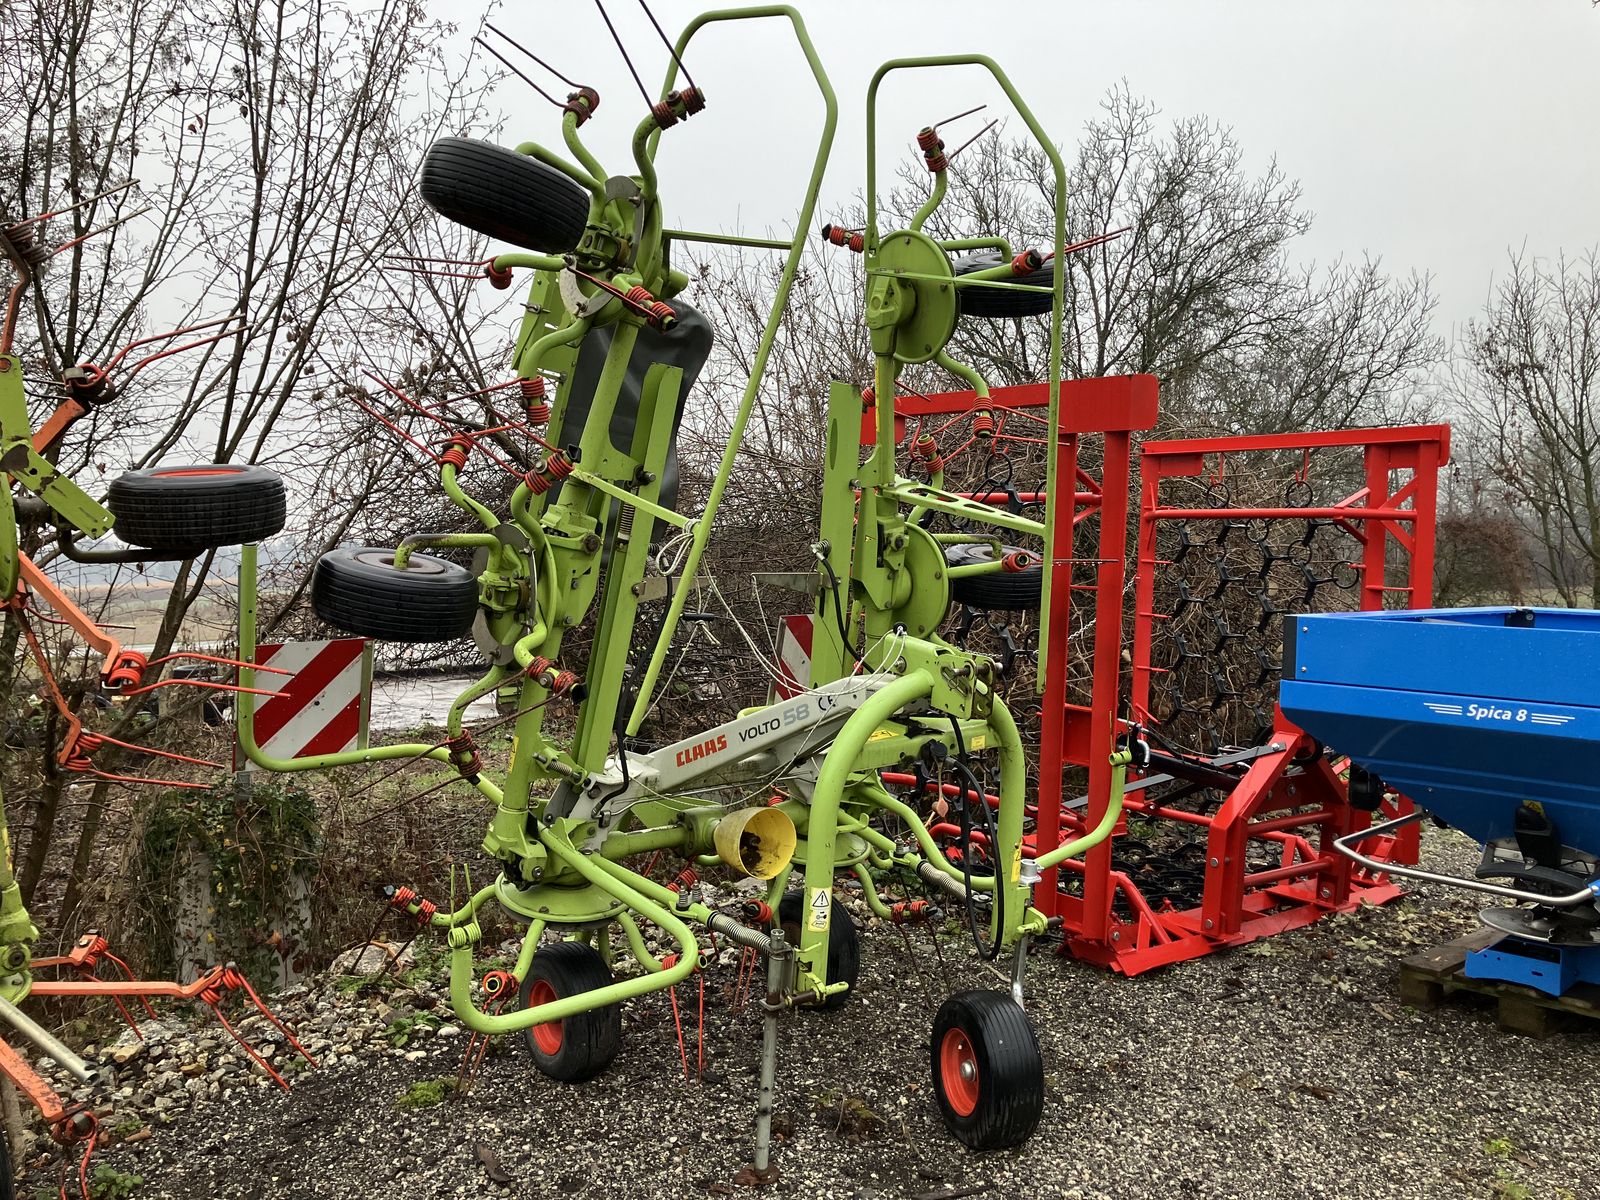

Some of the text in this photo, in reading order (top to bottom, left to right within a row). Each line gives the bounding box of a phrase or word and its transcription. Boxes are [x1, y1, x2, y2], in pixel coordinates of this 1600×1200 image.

[1466, 704, 1528, 721] Spica 8
[676, 703, 810, 767] CLAAS VOLTO 58
